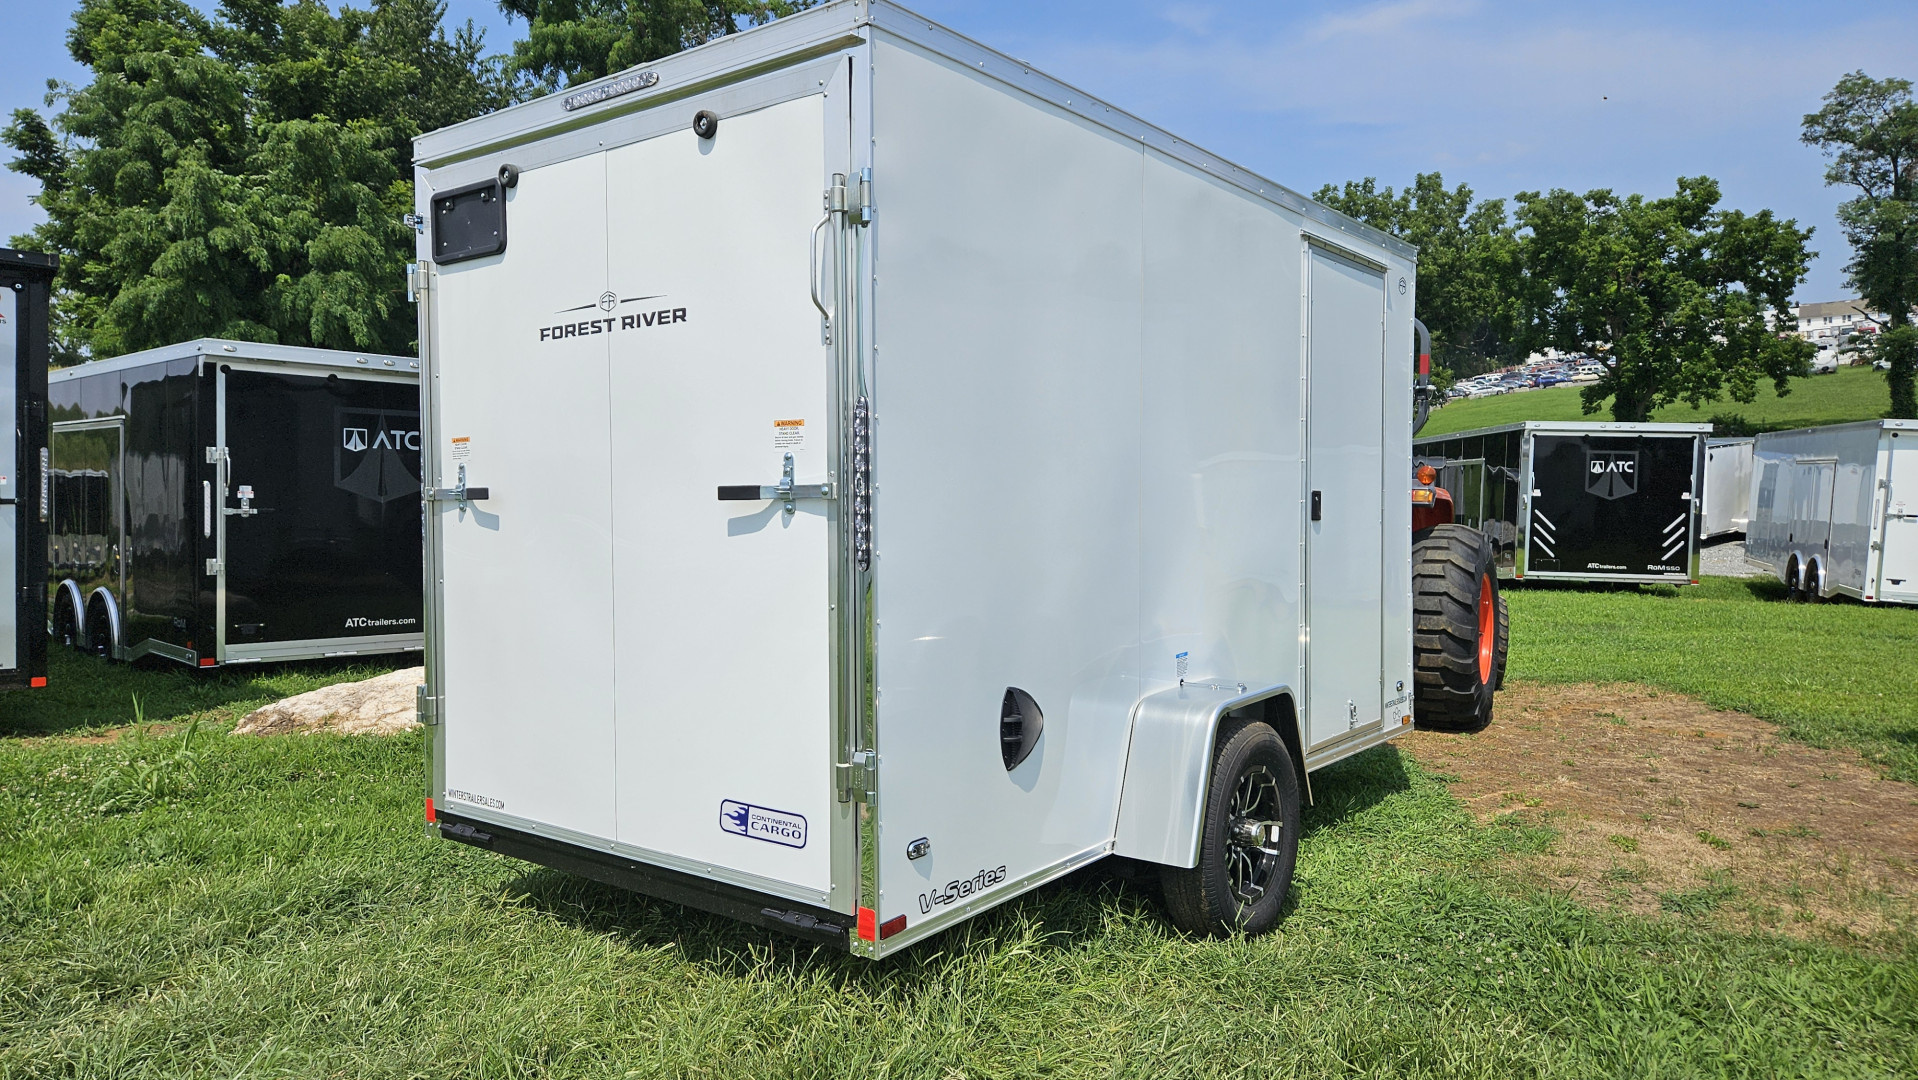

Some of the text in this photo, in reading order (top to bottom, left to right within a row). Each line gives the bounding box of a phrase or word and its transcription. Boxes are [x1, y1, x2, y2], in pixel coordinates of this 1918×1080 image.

[539, 307, 687, 342] FOREST RIVER
[372, 430, 420, 451] ATC
[1606, 461, 1634, 473] ATC
[345, 617, 417, 628] ATCtrailers.com
[751, 821, 802, 840] CARGO
[752, 814, 802, 830] CONTINENTAL
[919, 865, 1007, 914] V-Series
